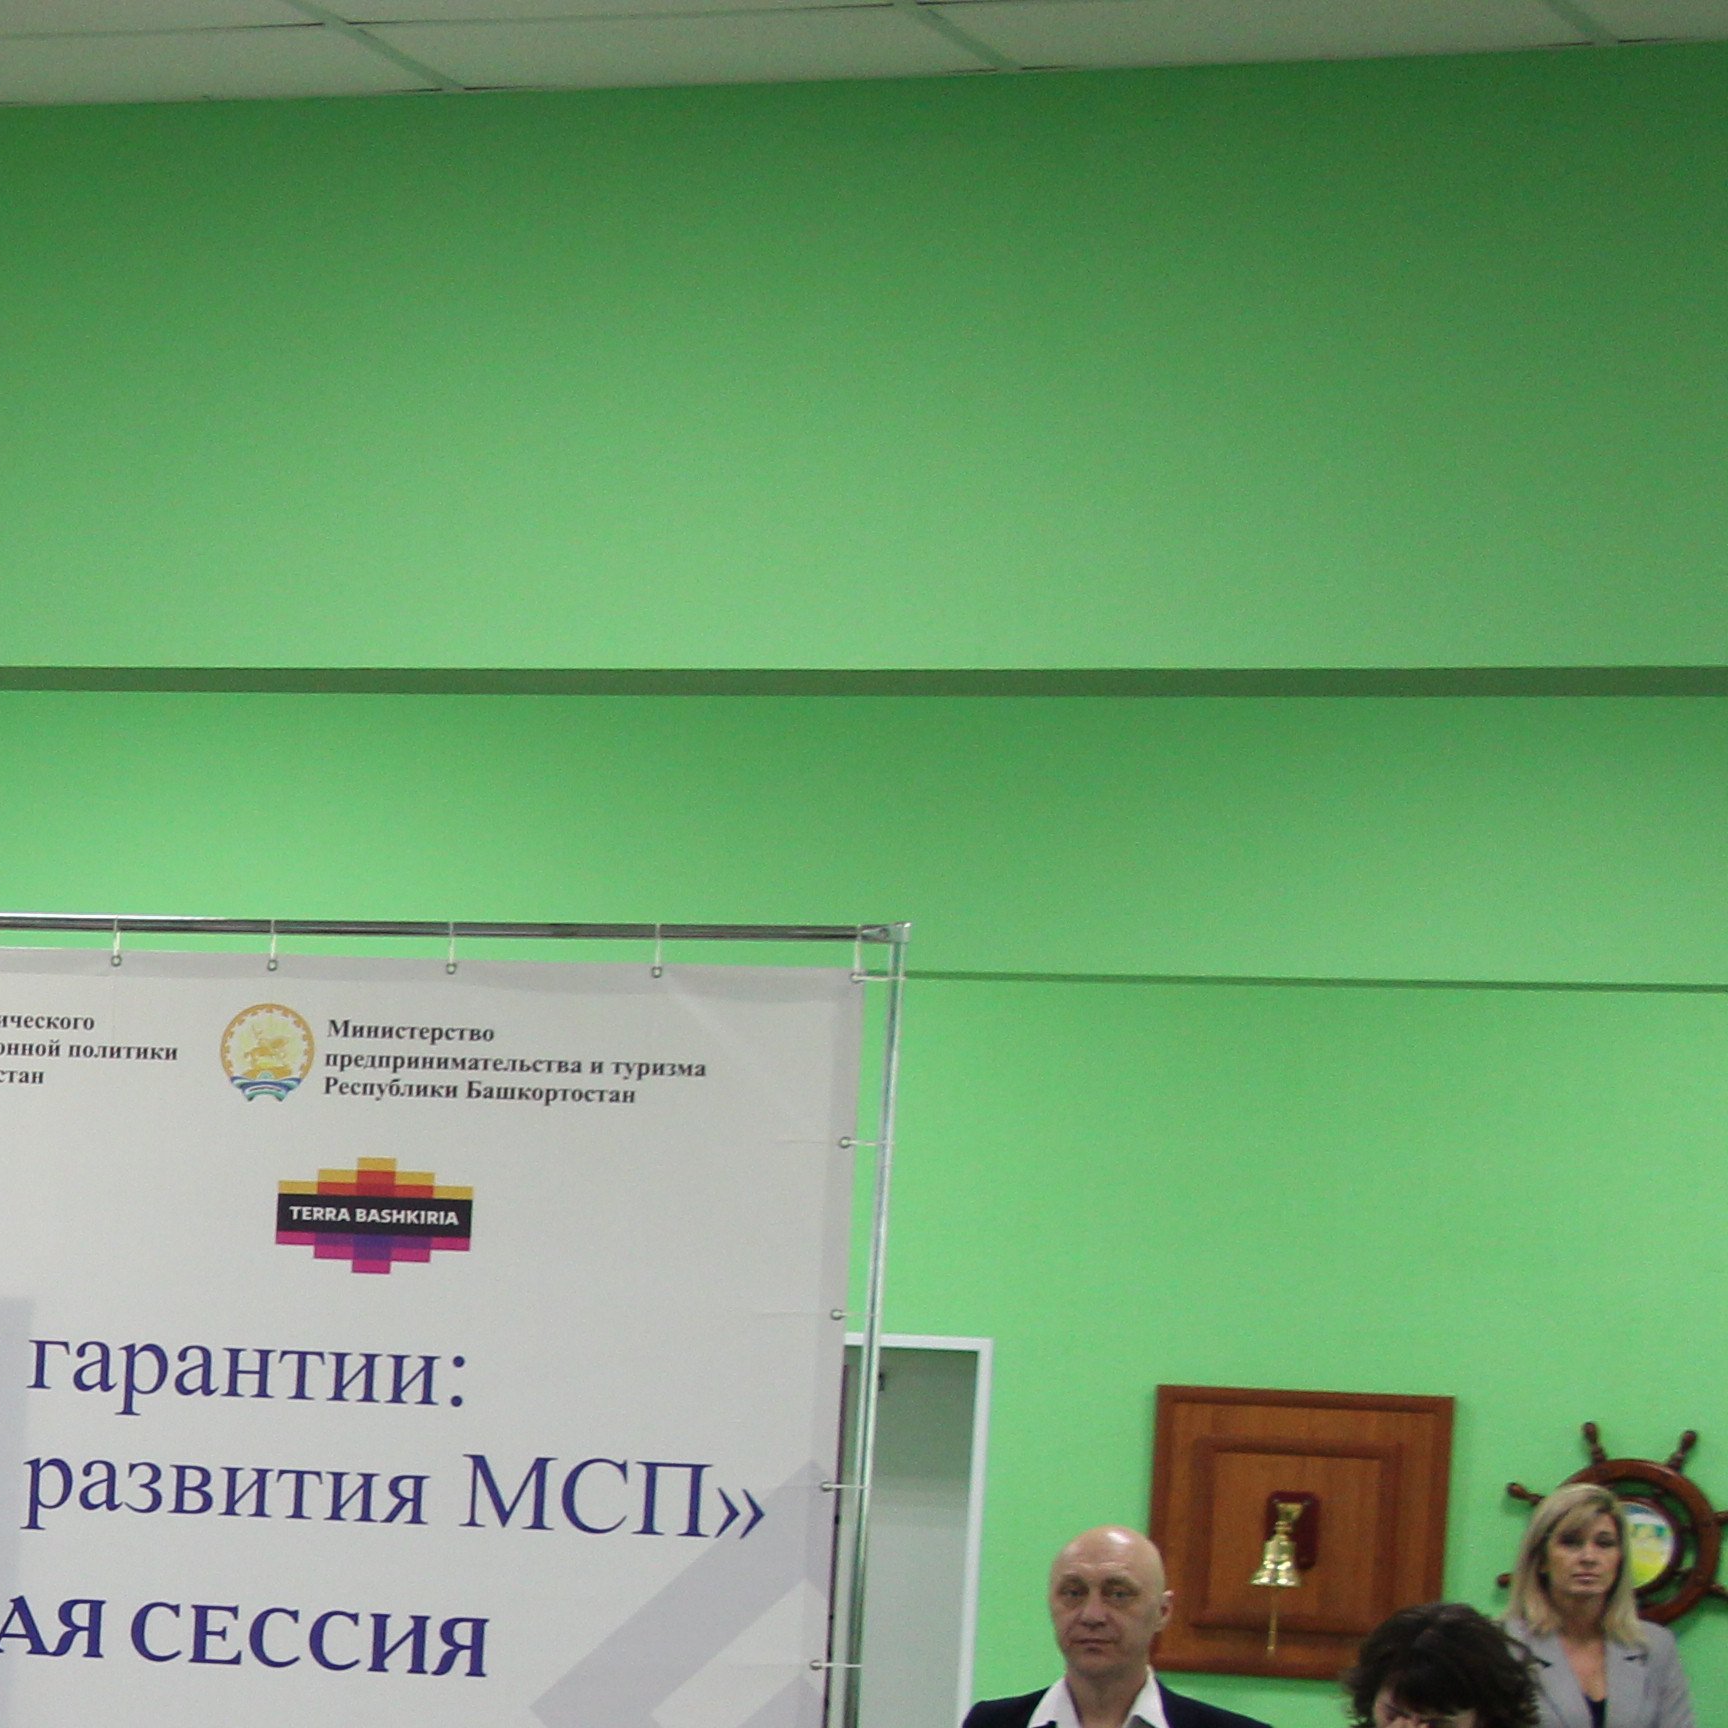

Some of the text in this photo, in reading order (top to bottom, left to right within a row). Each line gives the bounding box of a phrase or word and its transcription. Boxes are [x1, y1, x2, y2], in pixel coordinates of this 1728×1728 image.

[327, 1019, 495, 1045] Министерство
[67, 1045, 178, 1061] политики
[325, 1052, 706, 1079] предпринимательства и туризма
[324, 1077, 636, 1106] Республики Башкортостан
[289, 1206, 459, 1226] TERRA BASHKIRIA
[27, 1339, 467, 1415] гарантии:
[20, 1455, 429, 1530] развития
[458, 1453, 765, 1540] МСП»
[129, 1601, 489, 1678] СЕССИЯ
